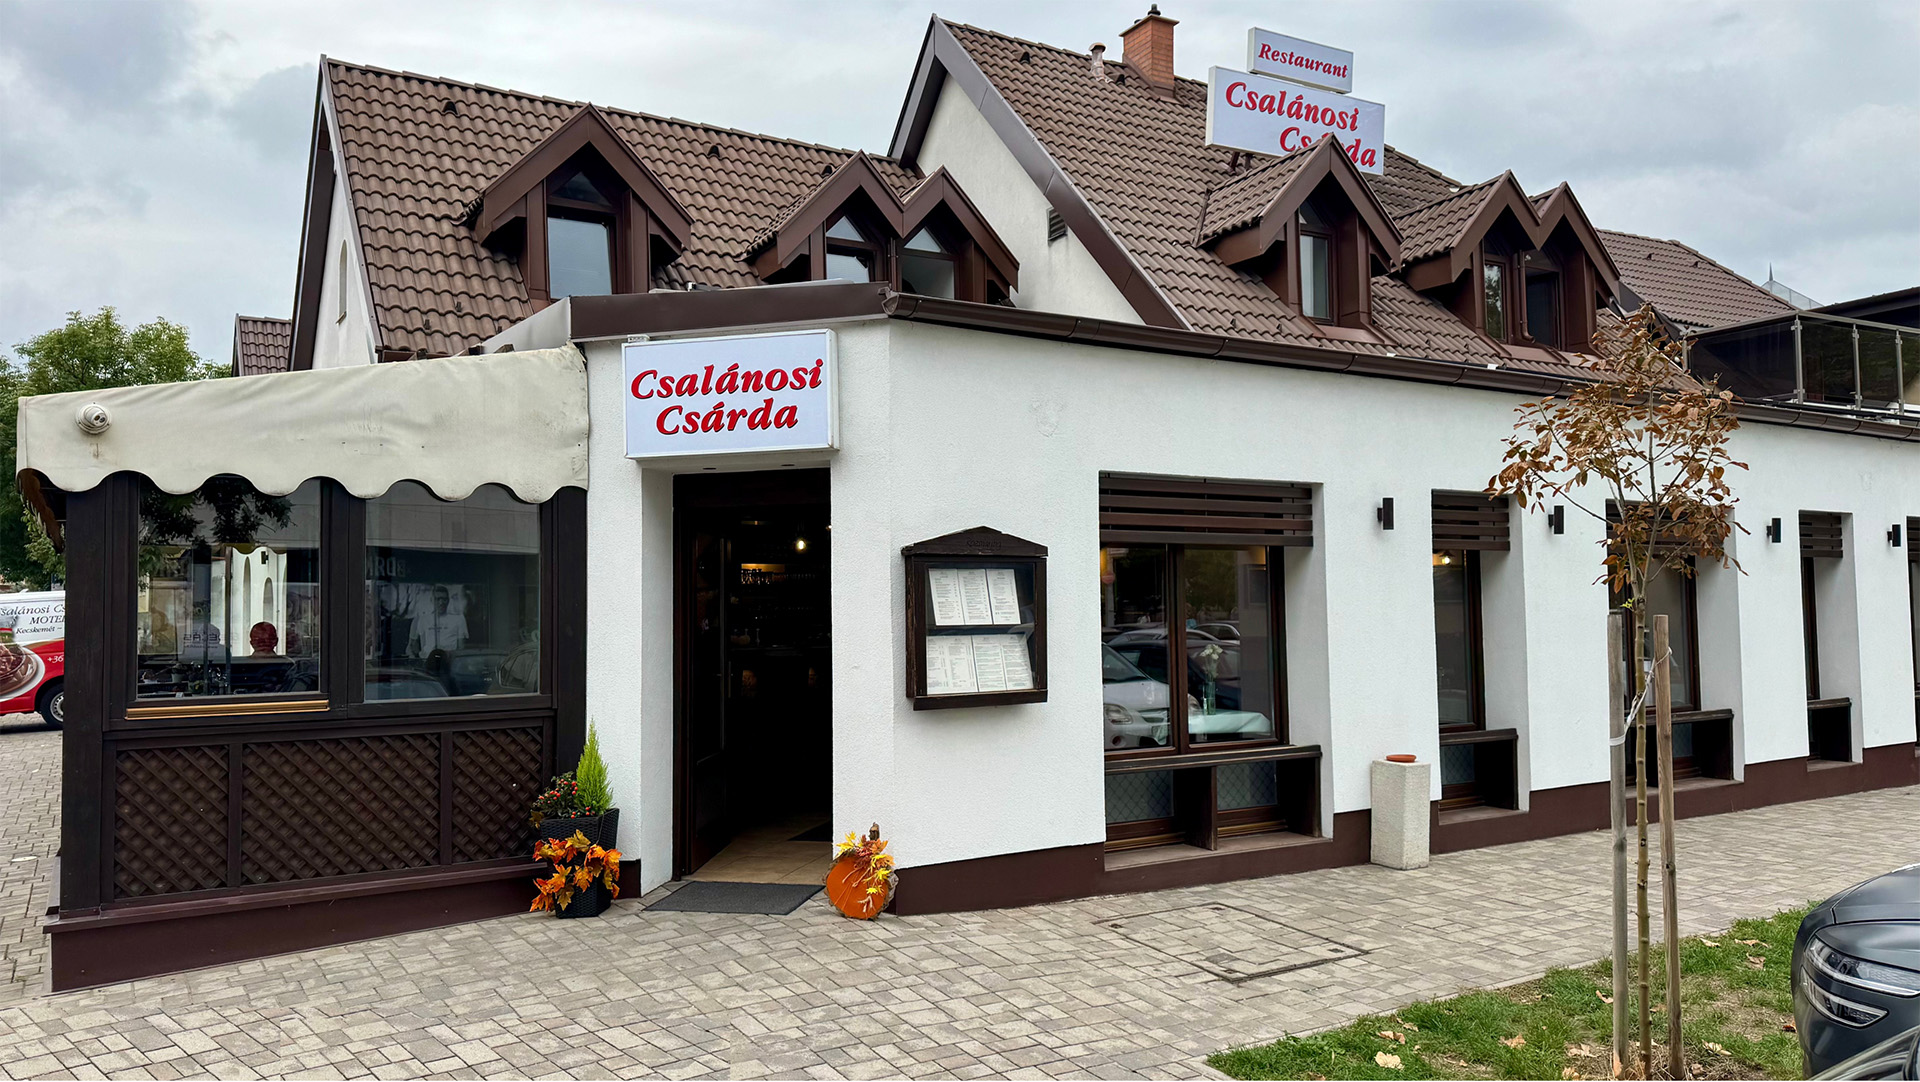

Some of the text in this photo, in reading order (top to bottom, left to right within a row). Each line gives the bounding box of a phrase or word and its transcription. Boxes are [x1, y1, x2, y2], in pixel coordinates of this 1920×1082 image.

[1257, 43, 1348, 79] Restaurant
[1225, 81, 1360, 132] Csalánosi
[1279, 126, 1376, 168] Csda
[630, 358, 824, 400] Csalánosi
[655, 397, 799, 435] Csárda
[0, 604, 51, 616] salánosi
[16, 626, 55, 635] Kecskemét
